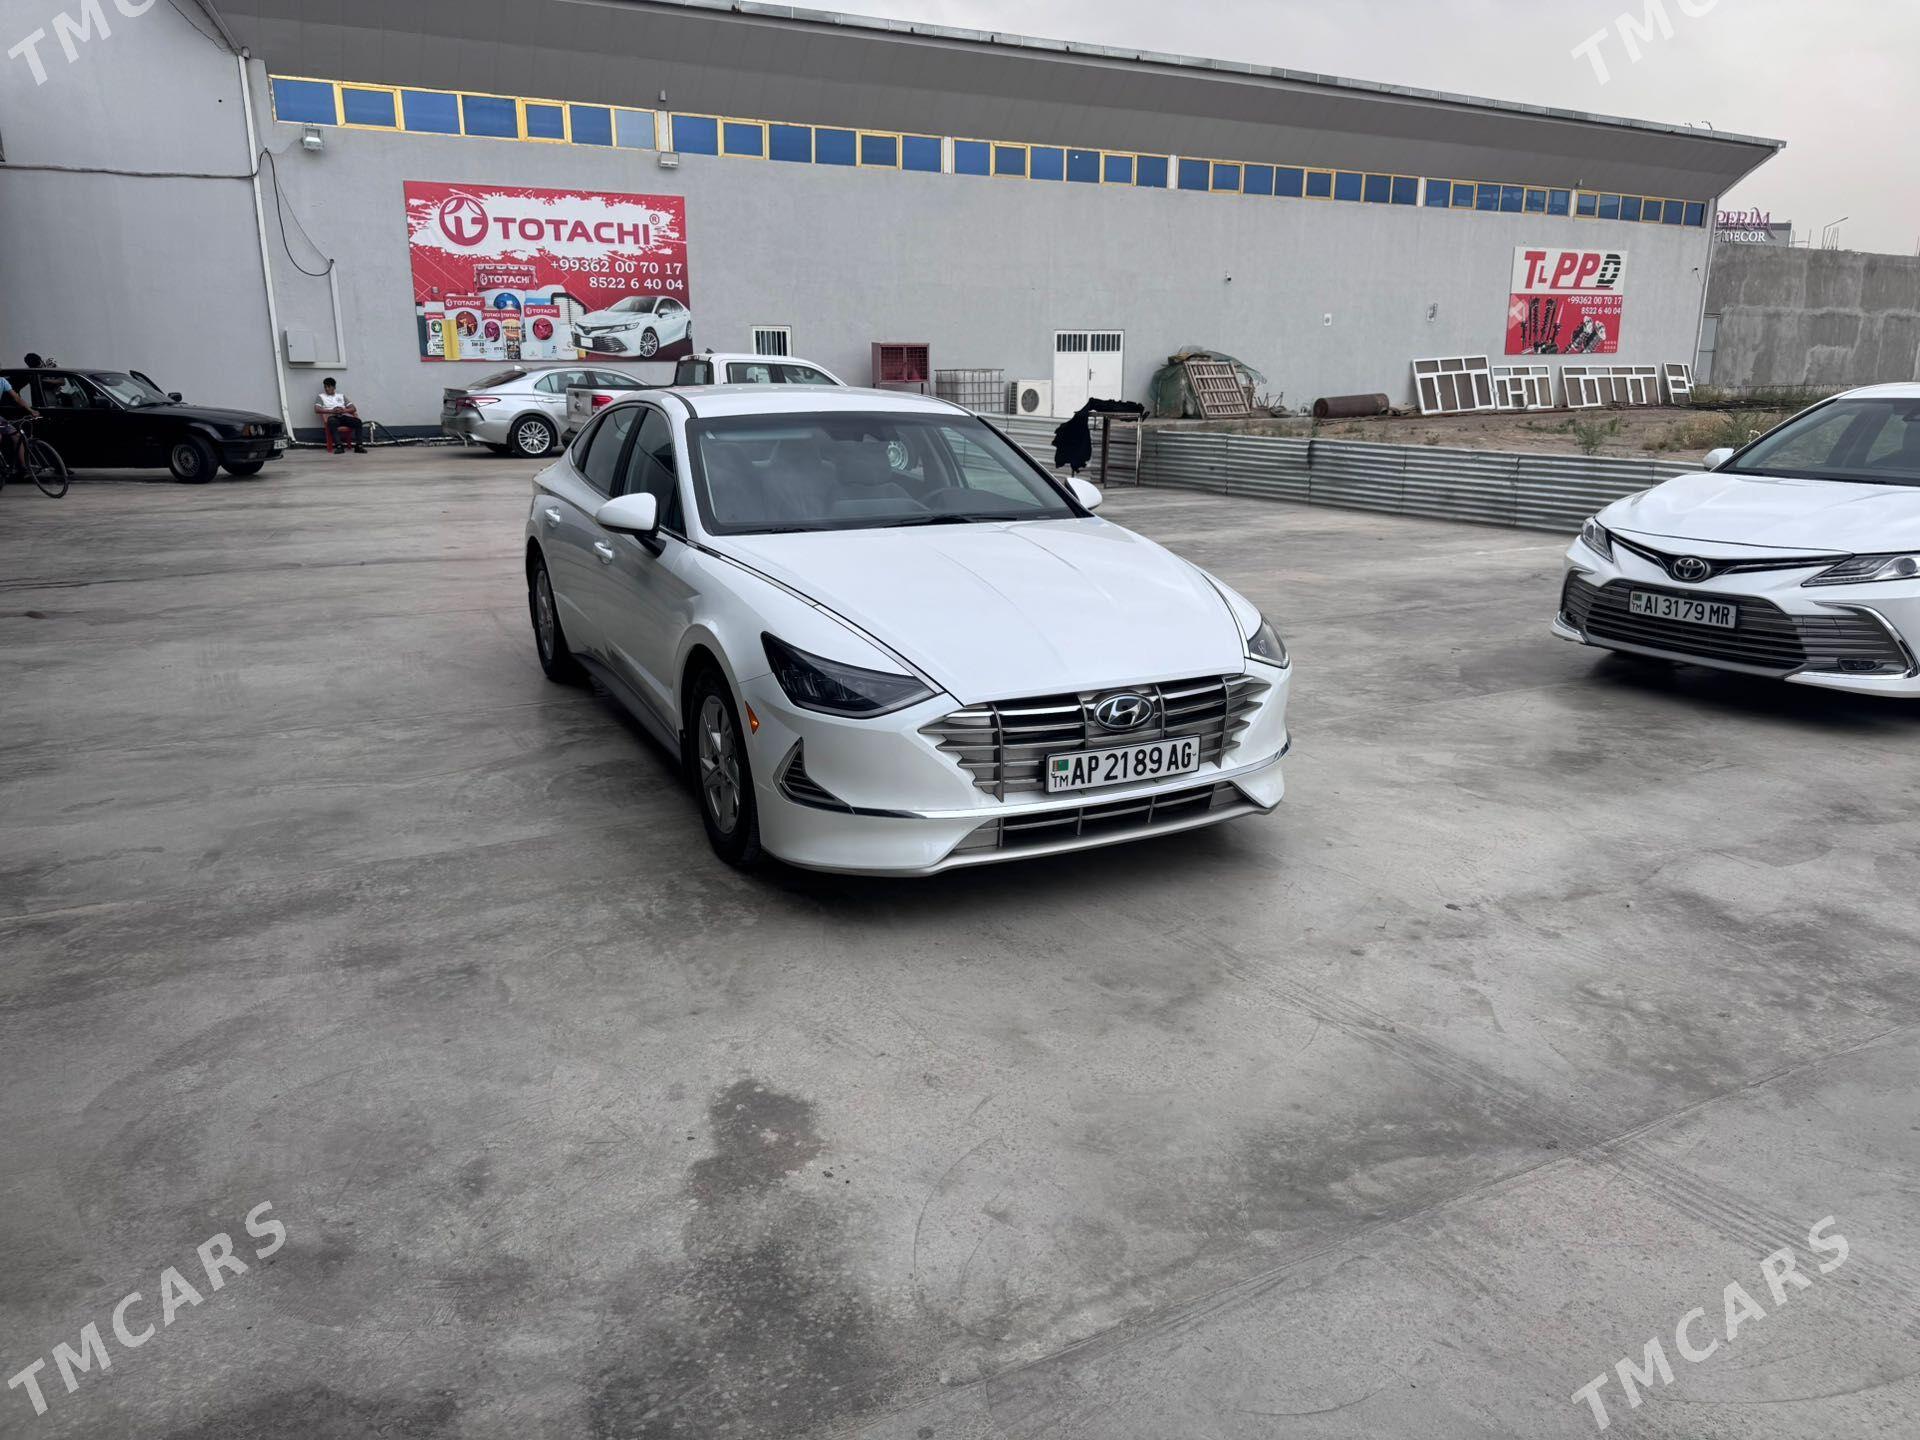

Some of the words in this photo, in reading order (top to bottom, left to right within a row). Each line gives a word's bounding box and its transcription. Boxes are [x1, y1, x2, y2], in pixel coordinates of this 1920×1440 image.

[493, 217, 650, 245] TOTACHI
[551, 259, 610, 273] +99362
[615, 260, 635, 273] 00
[640, 262, 659, 274] 70
[665, 263, 682, 275] 17
[488, 275, 530, 284] TOTACHI
[589, 276, 625, 289] 8522
[631, 278, 639, 289] 6
[644, 278, 661, 290] 40
[666, 279, 684, 290] 04
[1662, 598, 1705, 621] 3179
[1053, 775, 1069, 788] TM
[1071, 755, 1099, 785] AP
[1104, 747, 1163, 781] 2189
[1166, 742, 1192, 771] AG
